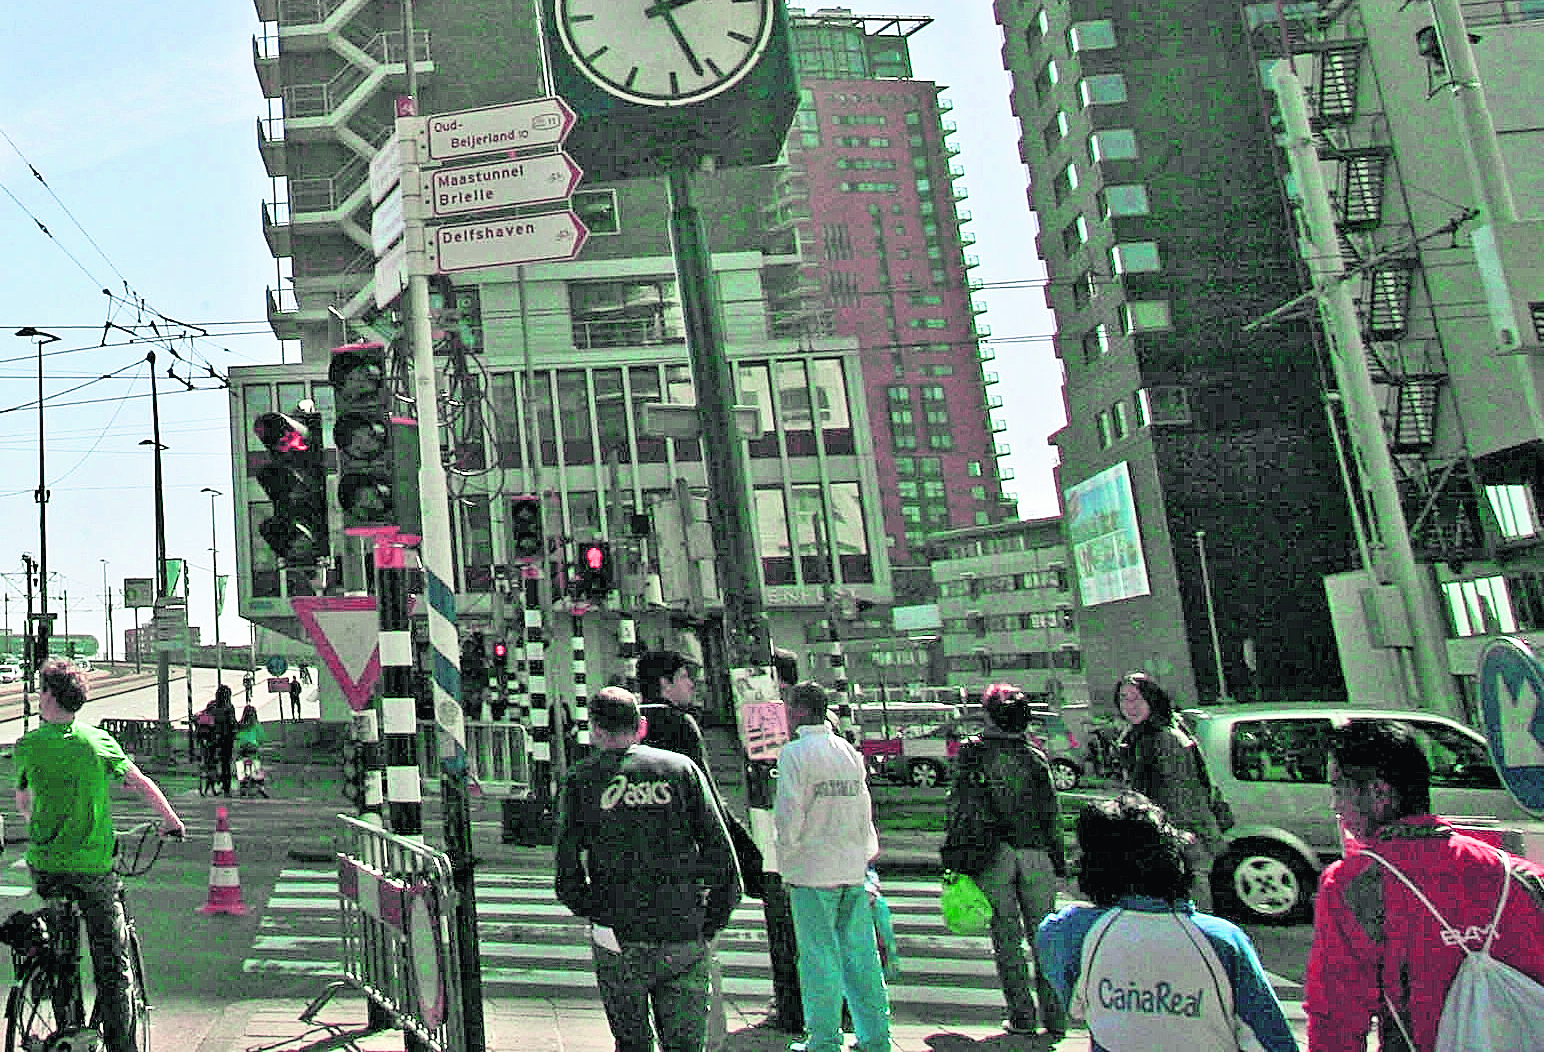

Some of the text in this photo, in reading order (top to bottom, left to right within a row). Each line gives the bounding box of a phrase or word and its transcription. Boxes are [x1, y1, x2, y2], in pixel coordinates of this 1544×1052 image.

[434, 119, 463, 133] Oud-
[451, 129, 515, 149] Beijerland
[438, 164, 524, 188] Maastunnel
[439, 189, 494, 206] Brielle
[442, 223, 535, 244] Delfshaven
